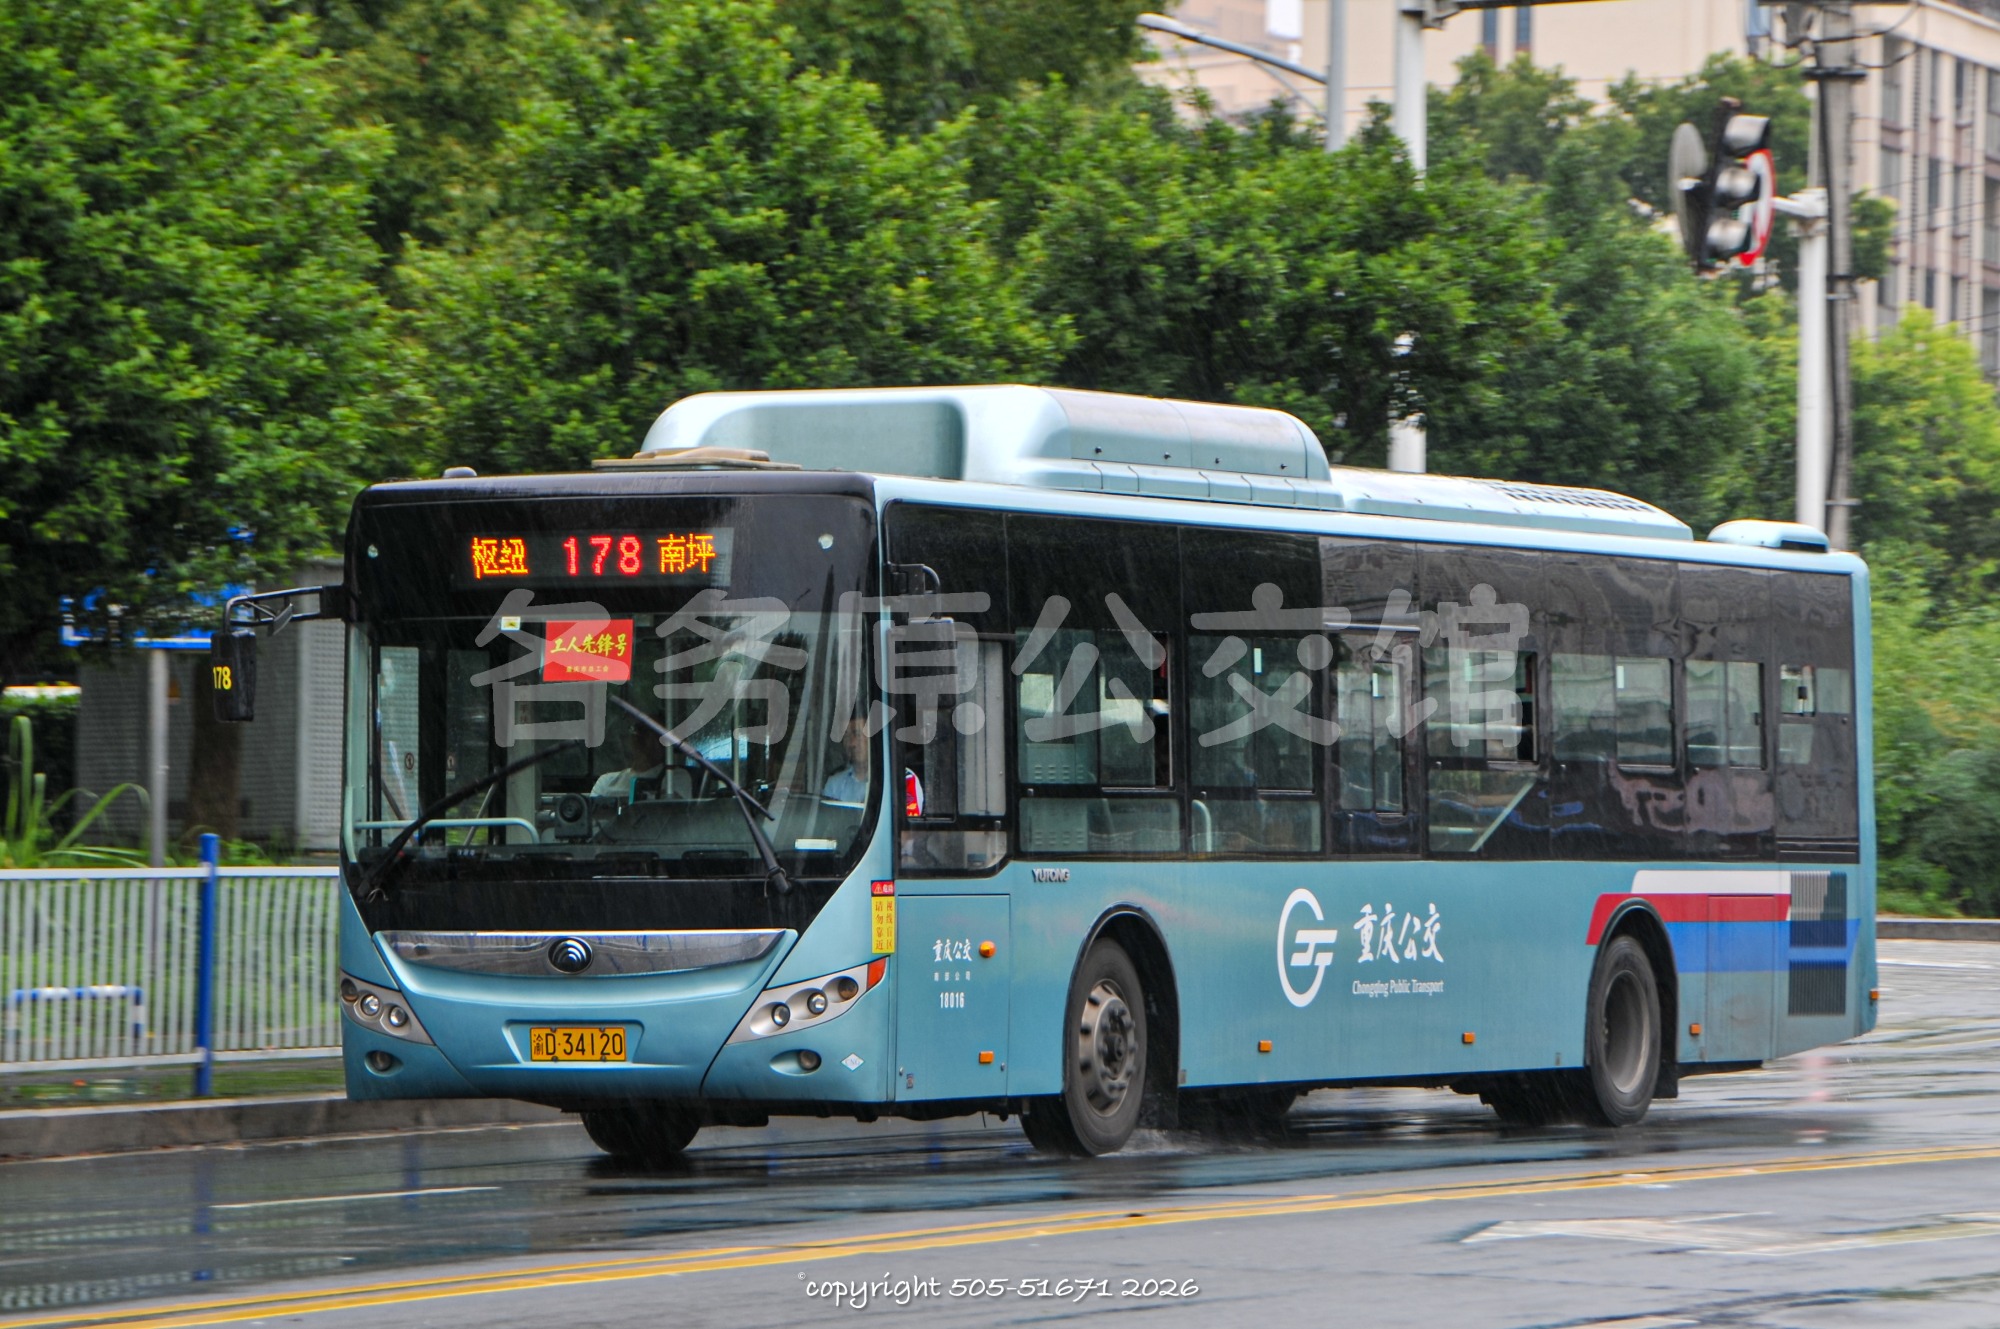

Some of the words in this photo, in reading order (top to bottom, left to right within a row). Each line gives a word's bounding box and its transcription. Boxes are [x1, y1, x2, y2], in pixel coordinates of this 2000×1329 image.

[472, 537, 528, 578] 枢纽
[564, 536, 641, 576] 178
[657, 533, 716, 573] 南坪
[550, 633, 627, 657] 工人先锋号
[213, 666, 232, 690] 178
[1032, 868, 1070, 882] YUTONG
[1353, 903, 1444, 963] 重庆公交
[932, 938, 973, 962] 重庆公交
[940, 992, 965, 1008] 18016
[1352, 980, 1389, 997] Chongqing
[1390, 979, 1410, 993] Public
[1411, 979, 1444, 995] Transport
